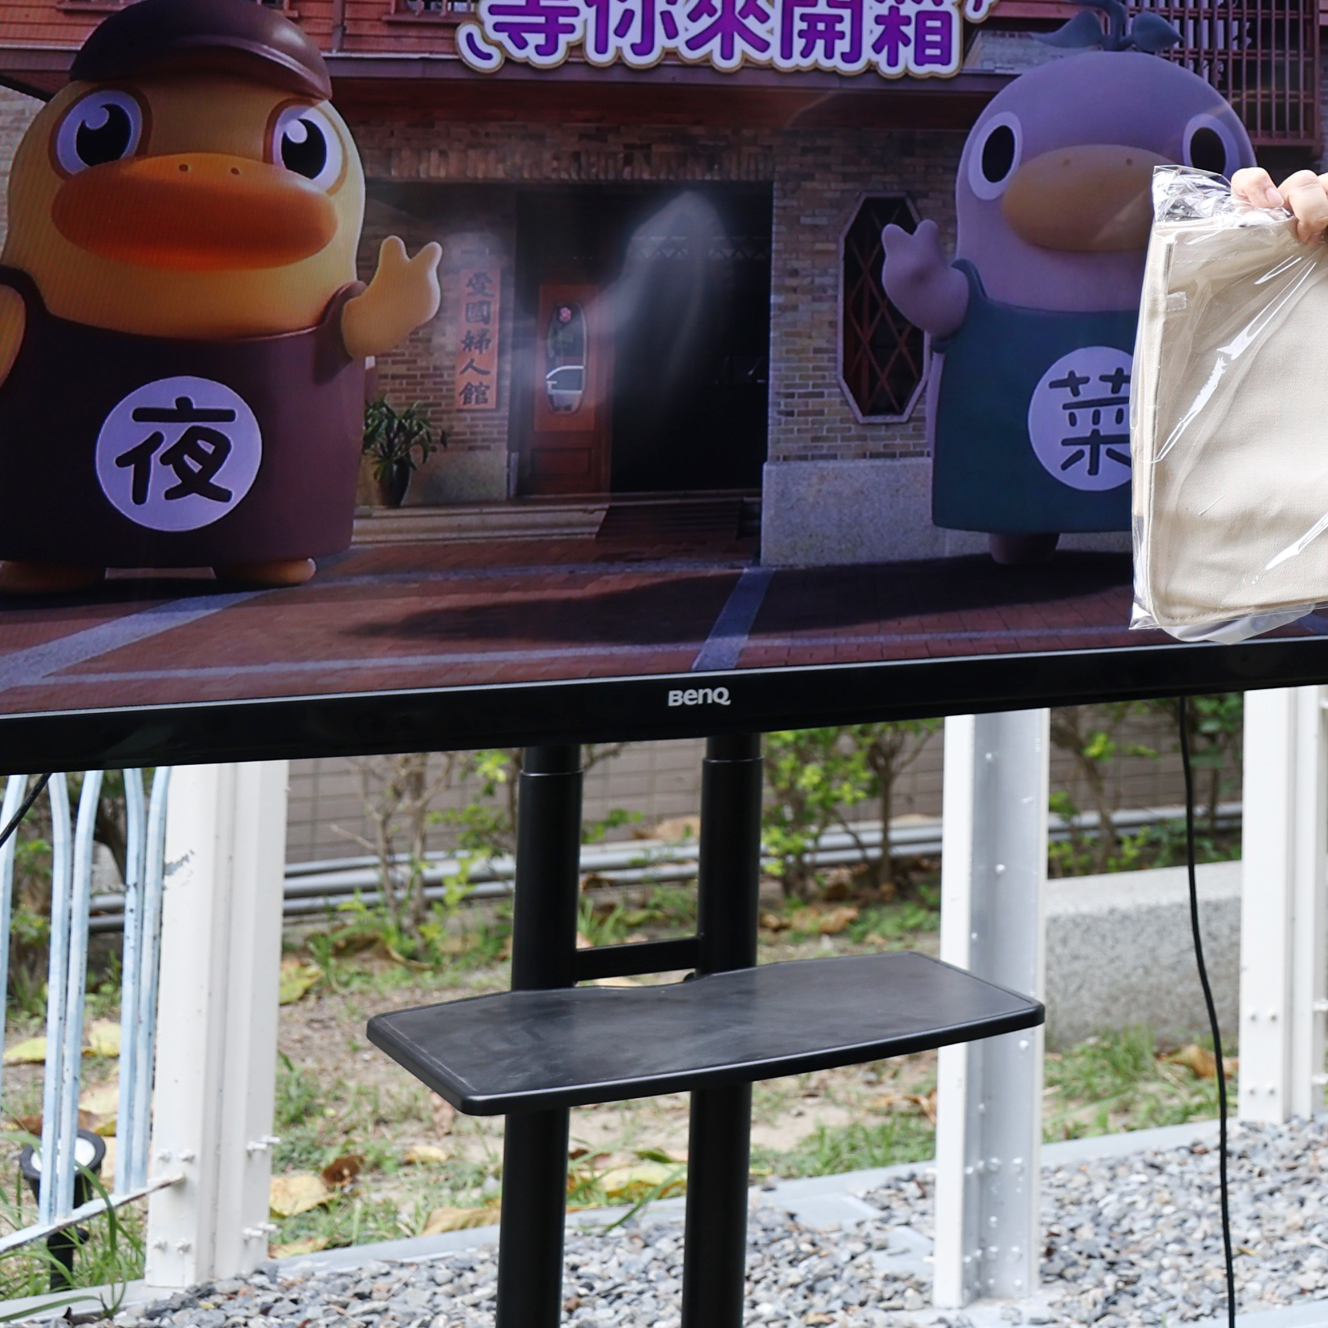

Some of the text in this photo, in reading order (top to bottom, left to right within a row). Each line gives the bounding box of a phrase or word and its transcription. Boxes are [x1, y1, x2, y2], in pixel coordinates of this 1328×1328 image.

[115, 396, 236, 505] 夜
[1049, 367, 1131, 476] 菜
[668, 686, 732, 707] BenQ
